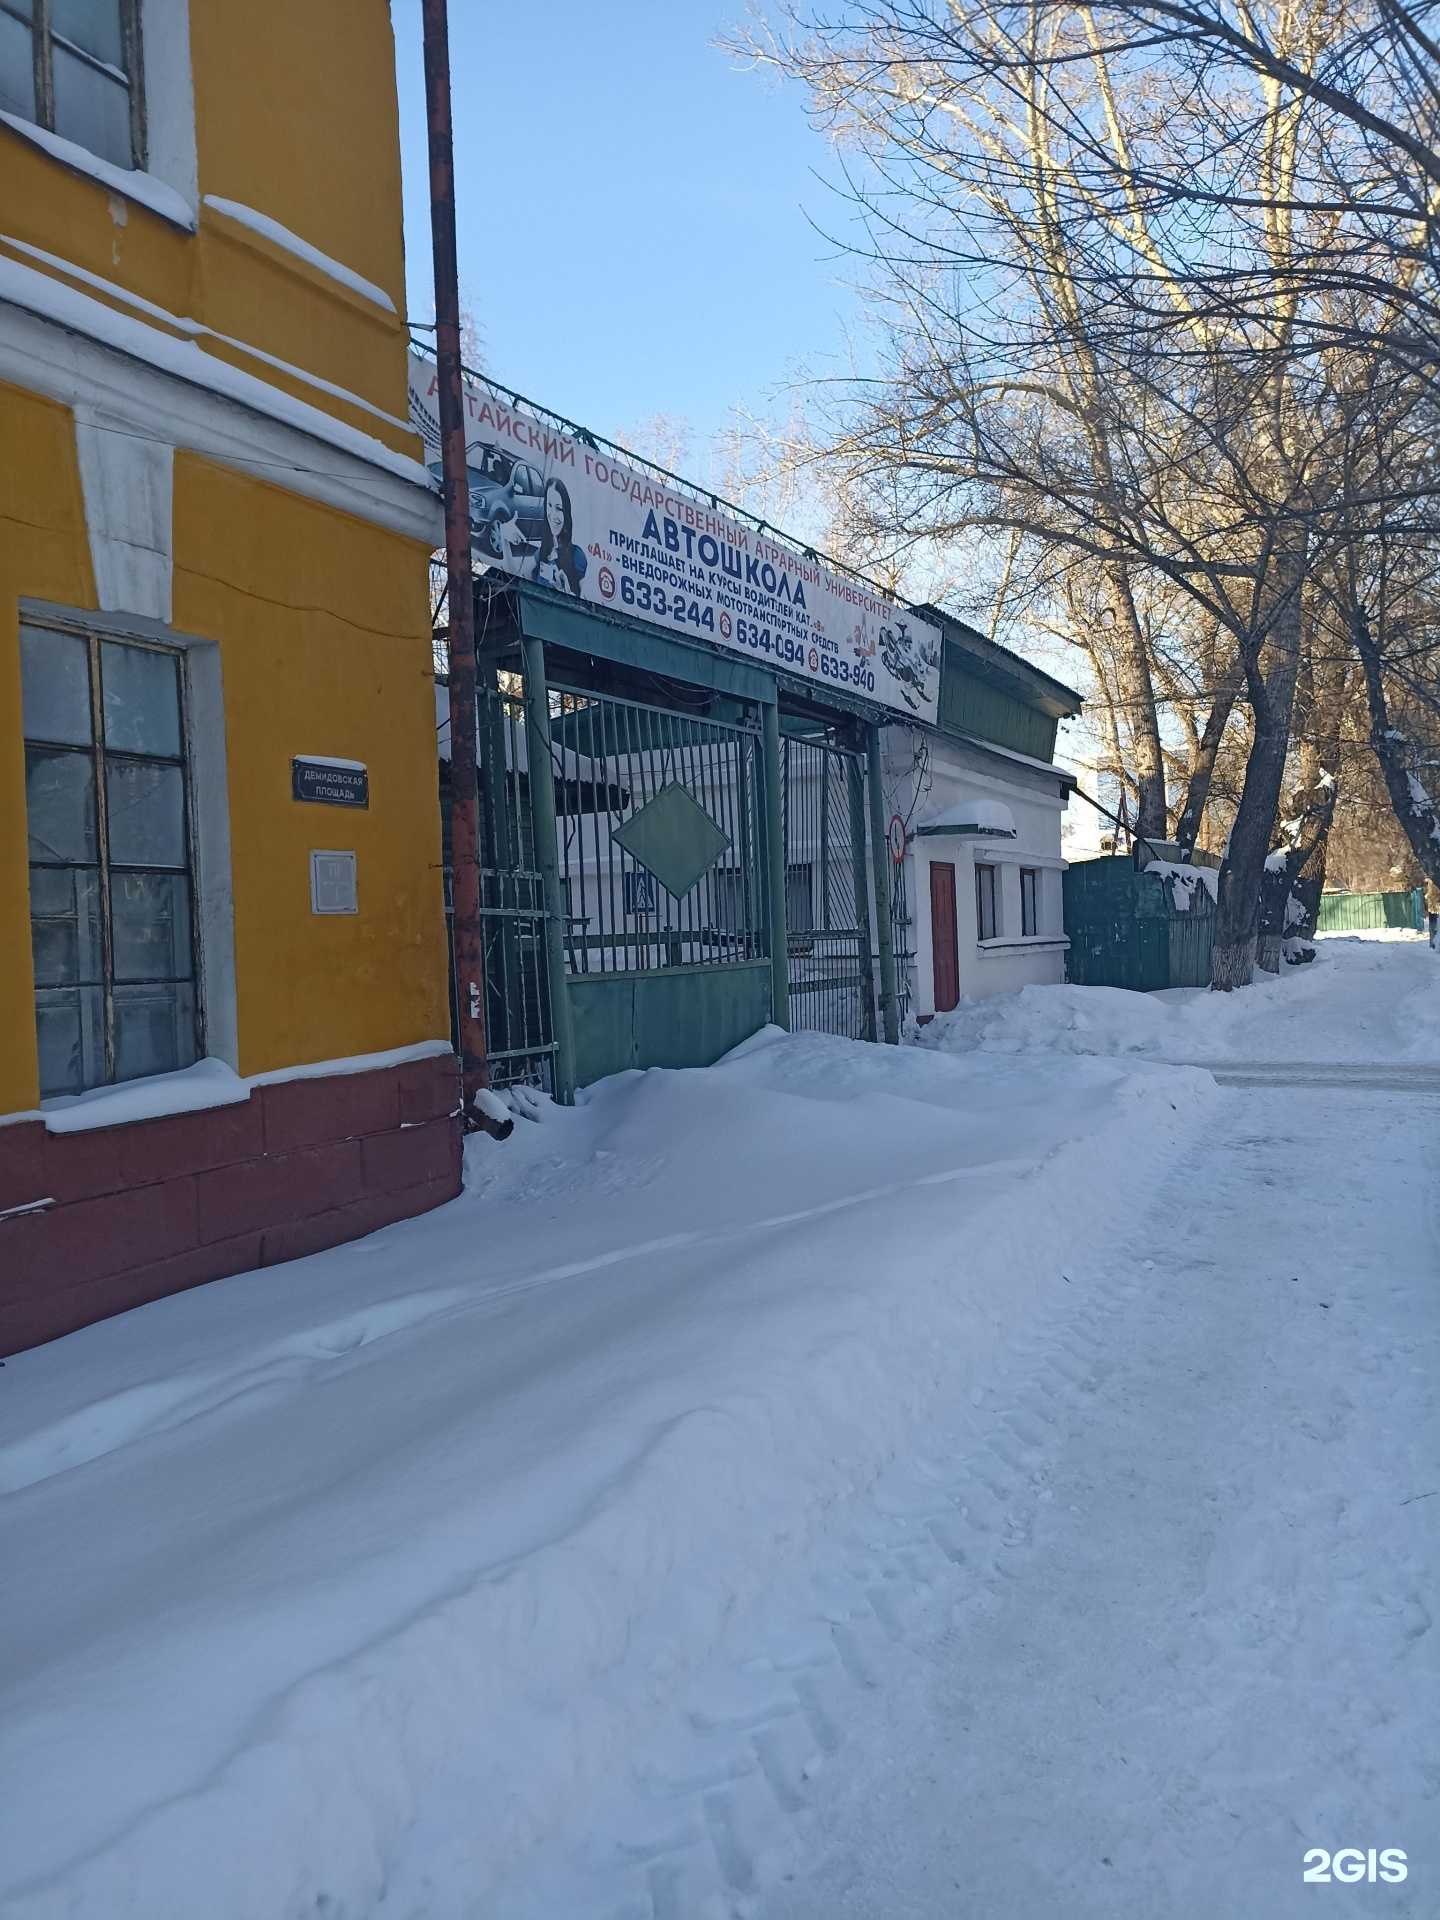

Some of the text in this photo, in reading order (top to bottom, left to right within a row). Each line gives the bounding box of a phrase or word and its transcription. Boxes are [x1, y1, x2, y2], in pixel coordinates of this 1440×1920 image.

[427, 375, 893, 621] АТАЙСКИЙ ГОСУДАРСТВЕННЫЙ АГРАРНЫЙ УНИВЕРСИТЕТ
[609, 529, 686, 574] ПРИГЛАШАЕТ
[689, 564, 705, 581] НА
[708, 571, 742, 597] КУРСЫ
[641, 508, 807, 609] АВТОШКОЛА
[620, 575, 875, 692] 633-244 634-094 633-940
[716, 590, 808, 641] МОТОТРАНСПОРТНЫХ
[811, 632, 839, 655] СРЕДСТВ
[304, 770, 363, 785] ДЕМИДОВСКАЯ
[315, 786, 355, 799] ПЛОЩАДЬ
